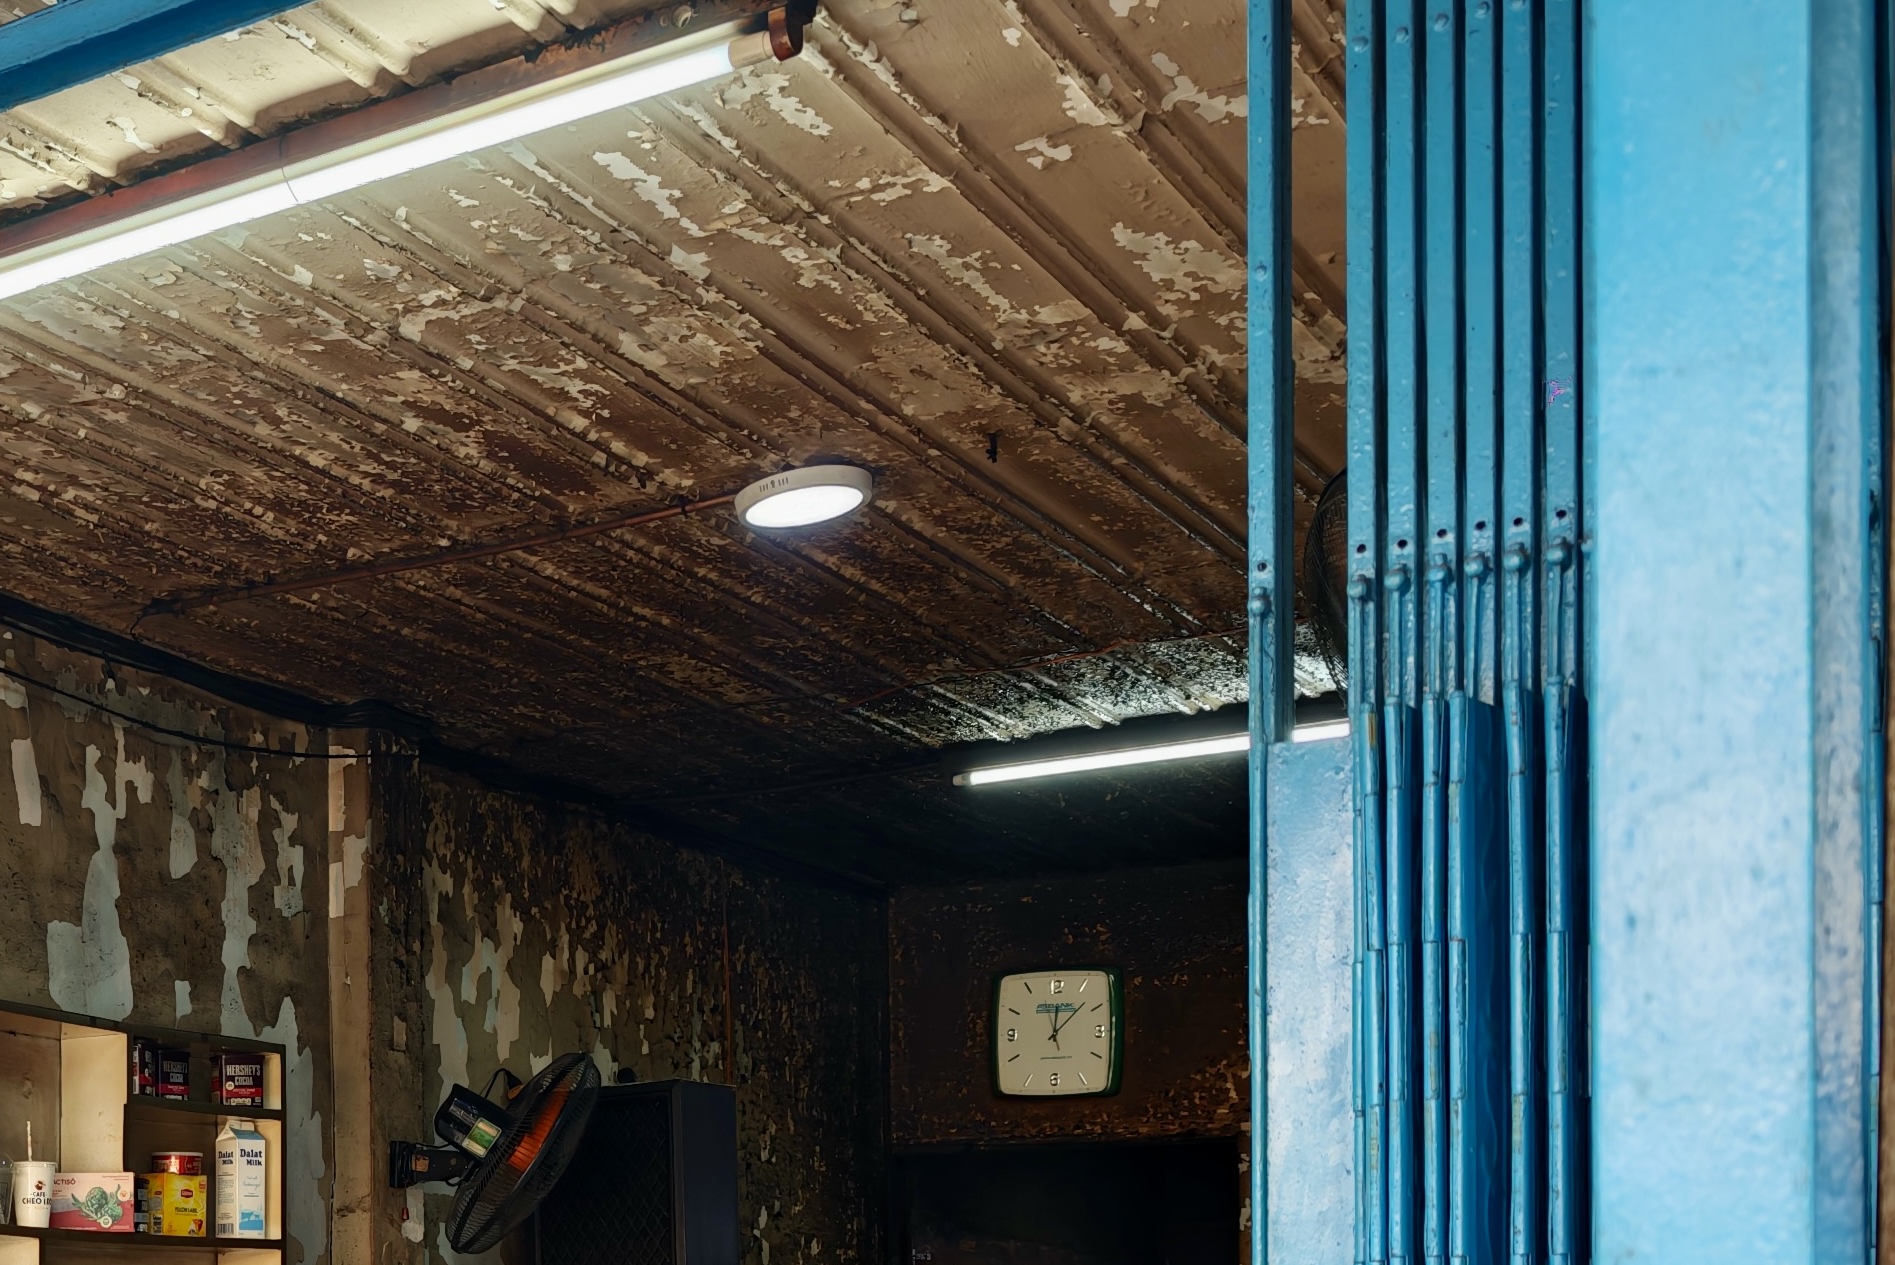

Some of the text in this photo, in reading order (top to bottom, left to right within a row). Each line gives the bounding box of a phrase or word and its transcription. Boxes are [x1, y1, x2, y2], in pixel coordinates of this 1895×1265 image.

[1050, 980, 1064, 995] 12
[1007, 1024, 1105, 1042] 9 3
[226, 1064, 261, 1076] HERSHEY'S
[234, 1076, 253, 1086] COCOA
[1050, 1072, 1061, 1087] 6
[218, 1151, 234, 1159] Dalat
[240, 1149, 263, 1158] Dalat
